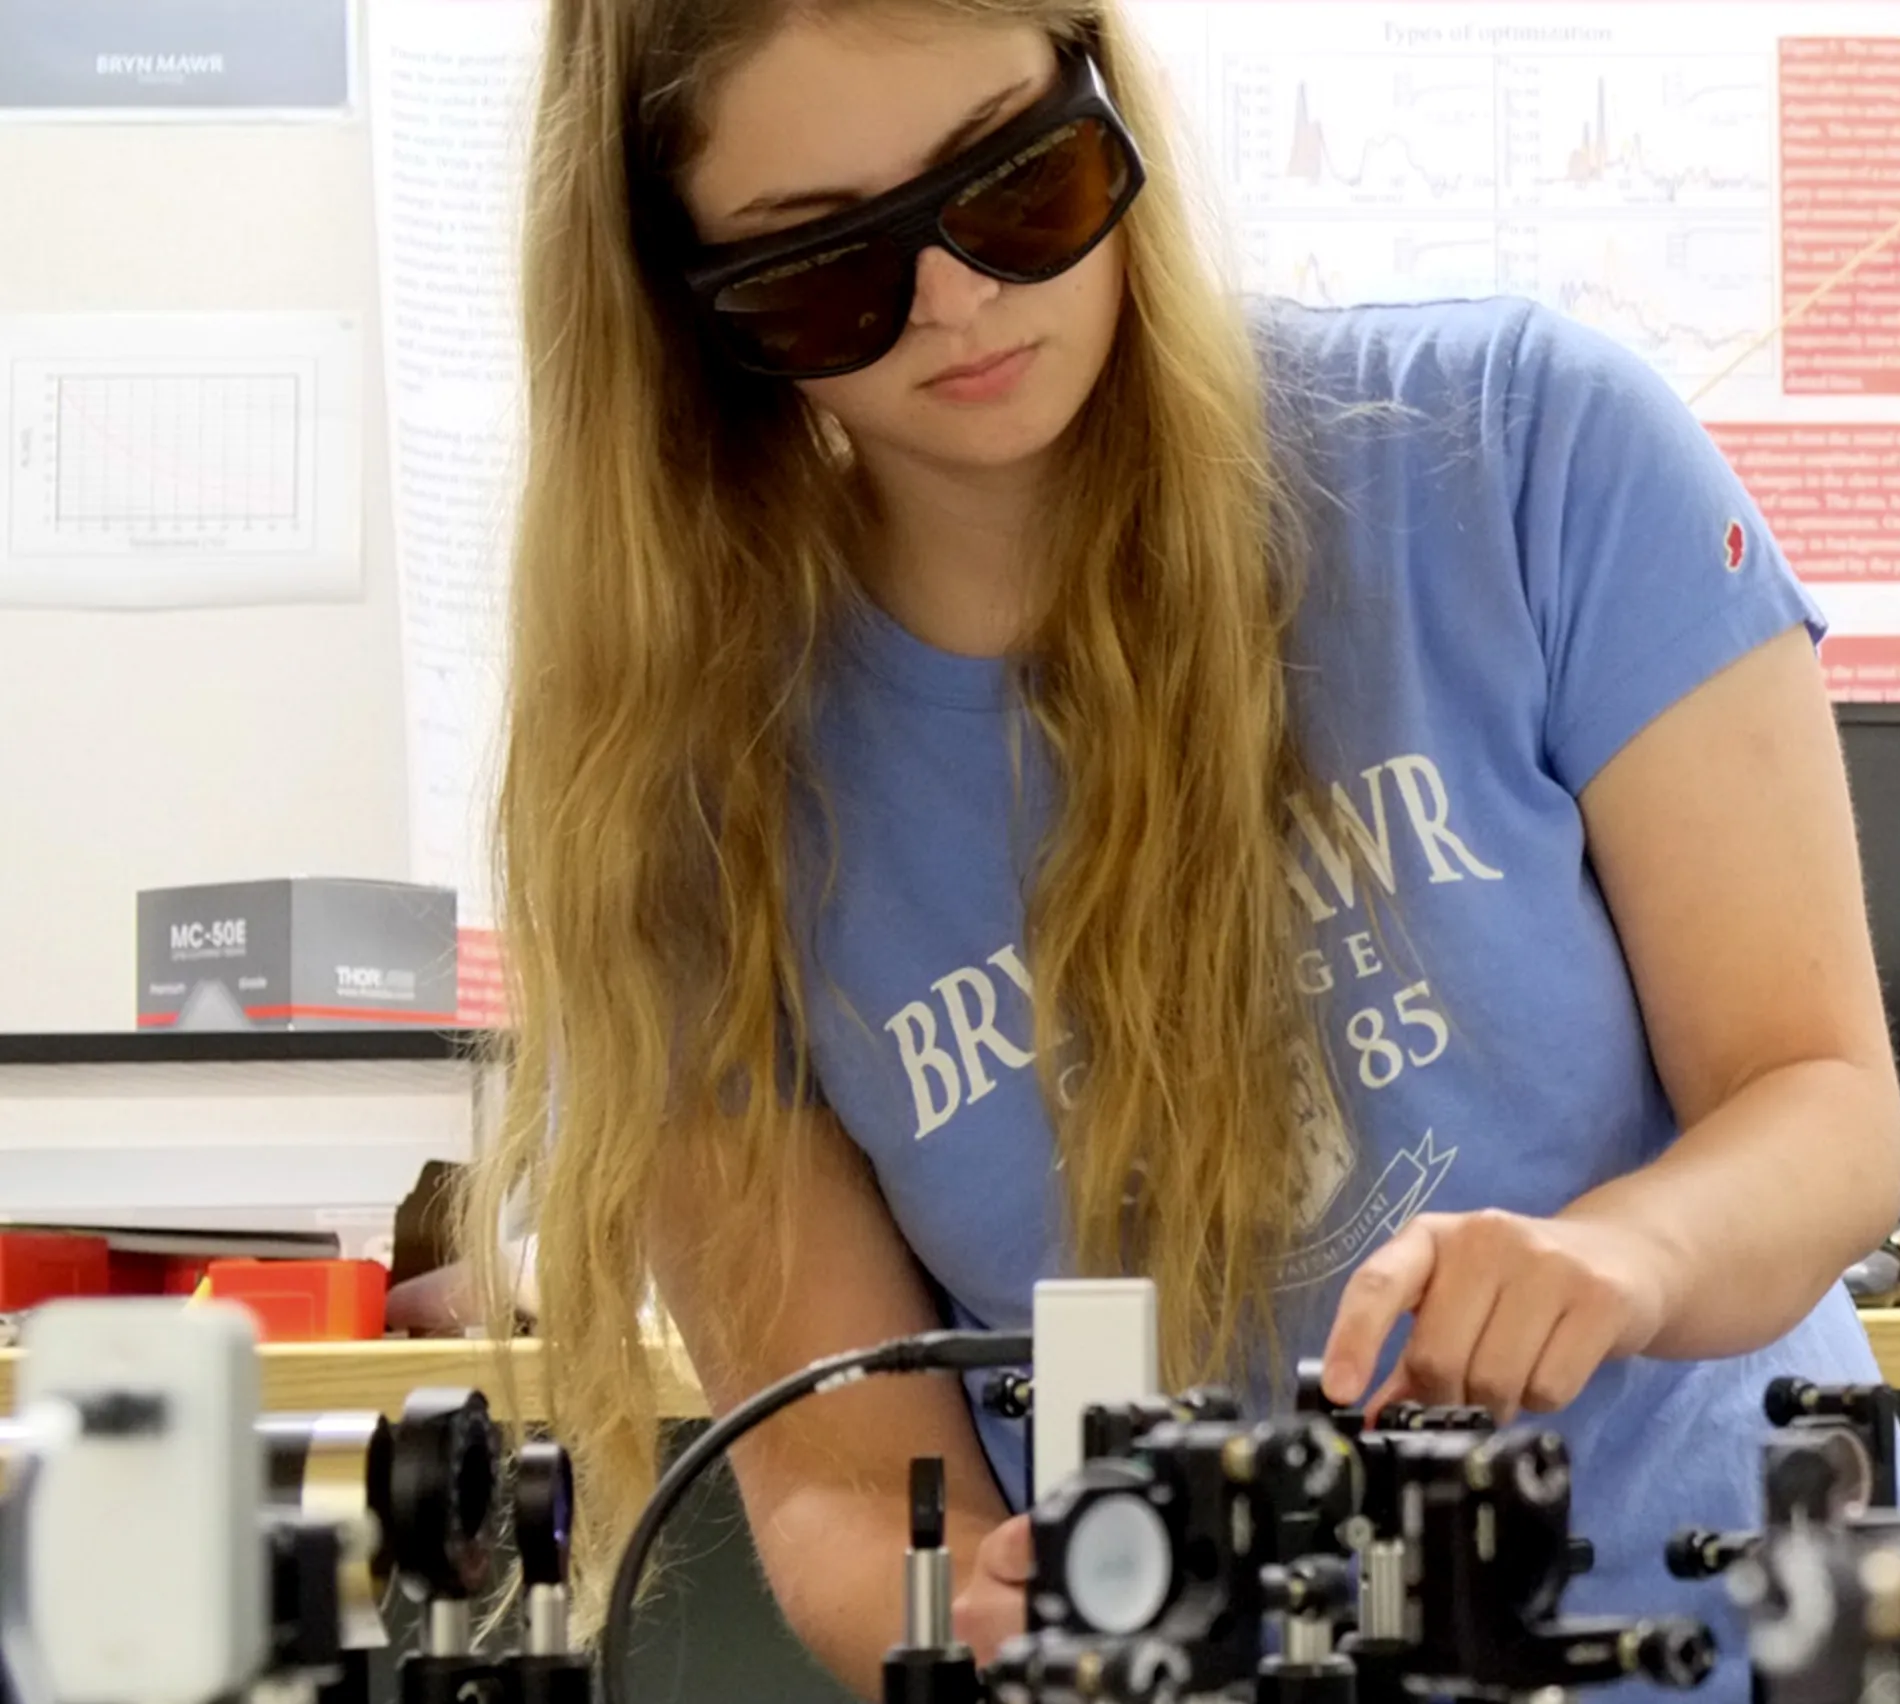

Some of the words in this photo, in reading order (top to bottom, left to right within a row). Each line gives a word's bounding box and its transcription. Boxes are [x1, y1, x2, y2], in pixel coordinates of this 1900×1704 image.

[1381, 20, 1443, 46] Types
[1449, 22, 1475, 42] of
[1478, 23, 1613, 47] optimization
[96, 52, 153, 74] BRYN
[156, 52, 224, 74] MAWR
[1279, 753, 1504, 924] WR
[171, 918, 247, 950] MC-50E
[1346, 980, 1450, 1089] 85
[1342, 1192, 1390, 1251] DILEXI
